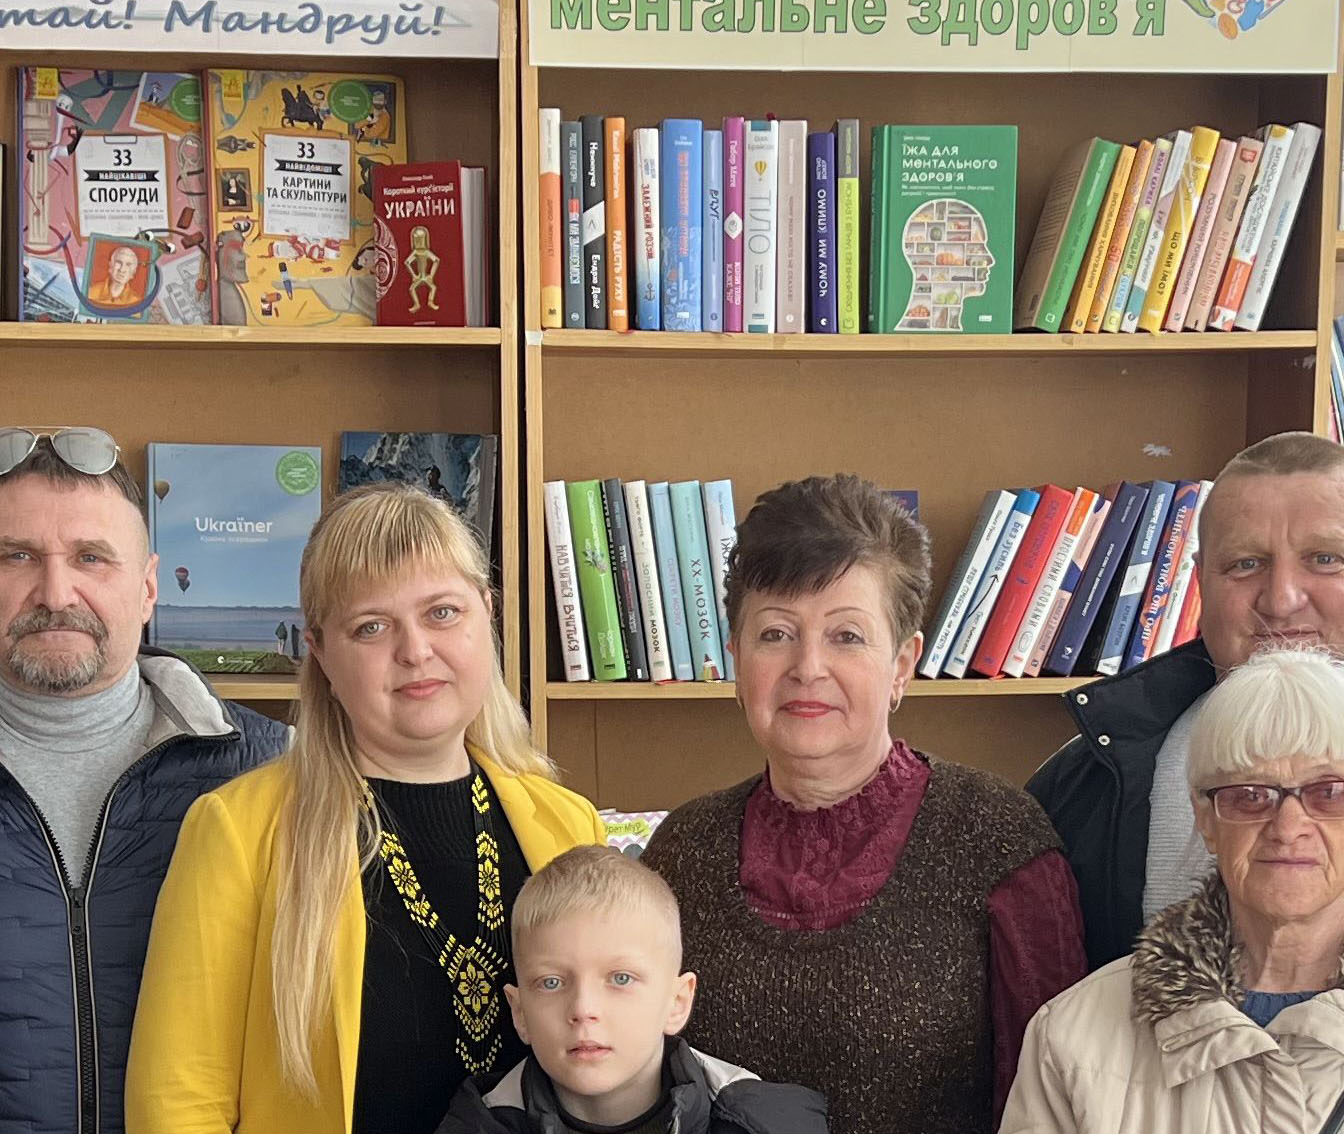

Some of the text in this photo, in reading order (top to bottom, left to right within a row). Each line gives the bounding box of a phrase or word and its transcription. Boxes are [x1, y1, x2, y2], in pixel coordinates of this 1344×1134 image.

[163, 2, 447, 45] Мандруй!
[550, 0, 886, 35] ментальне
[112, 149, 133, 167] 33
[296, 141, 316, 159] 33
[902, 144, 959, 156] ЇЖА ДЛЯ
[902, 158, 998, 170] МЕНТАЛЬНОГО
[282, 175, 332, 190] КАРТИНИ
[901, 171, 964, 183] ЗДОРОВ'Я
[89, 187, 160, 206] СПОРУДИ
[266, 187, 348, 204] ТА СКУЛЬПТУРИ
[384, 195, 455, 219] УКРАЇНИ
[747, 189, 772, 255] ТІЛО
[817, 239, 828, 258] МИ
[1167, 230, 1182, 250] ЩО
[1163, 251, 1175, 268] МИ
[817, 261, 828, 297] ЧОМУ
[1045, 534, 1074, 582] ПРОСТИМИ
[1140, 502, 1187, 641] ПРО ЩО ВОНА МОВЧИТЬ
[1027, 582, 1055, 629] СЛОВАМИ
[650, 618, 661, 653] МОЗОК
